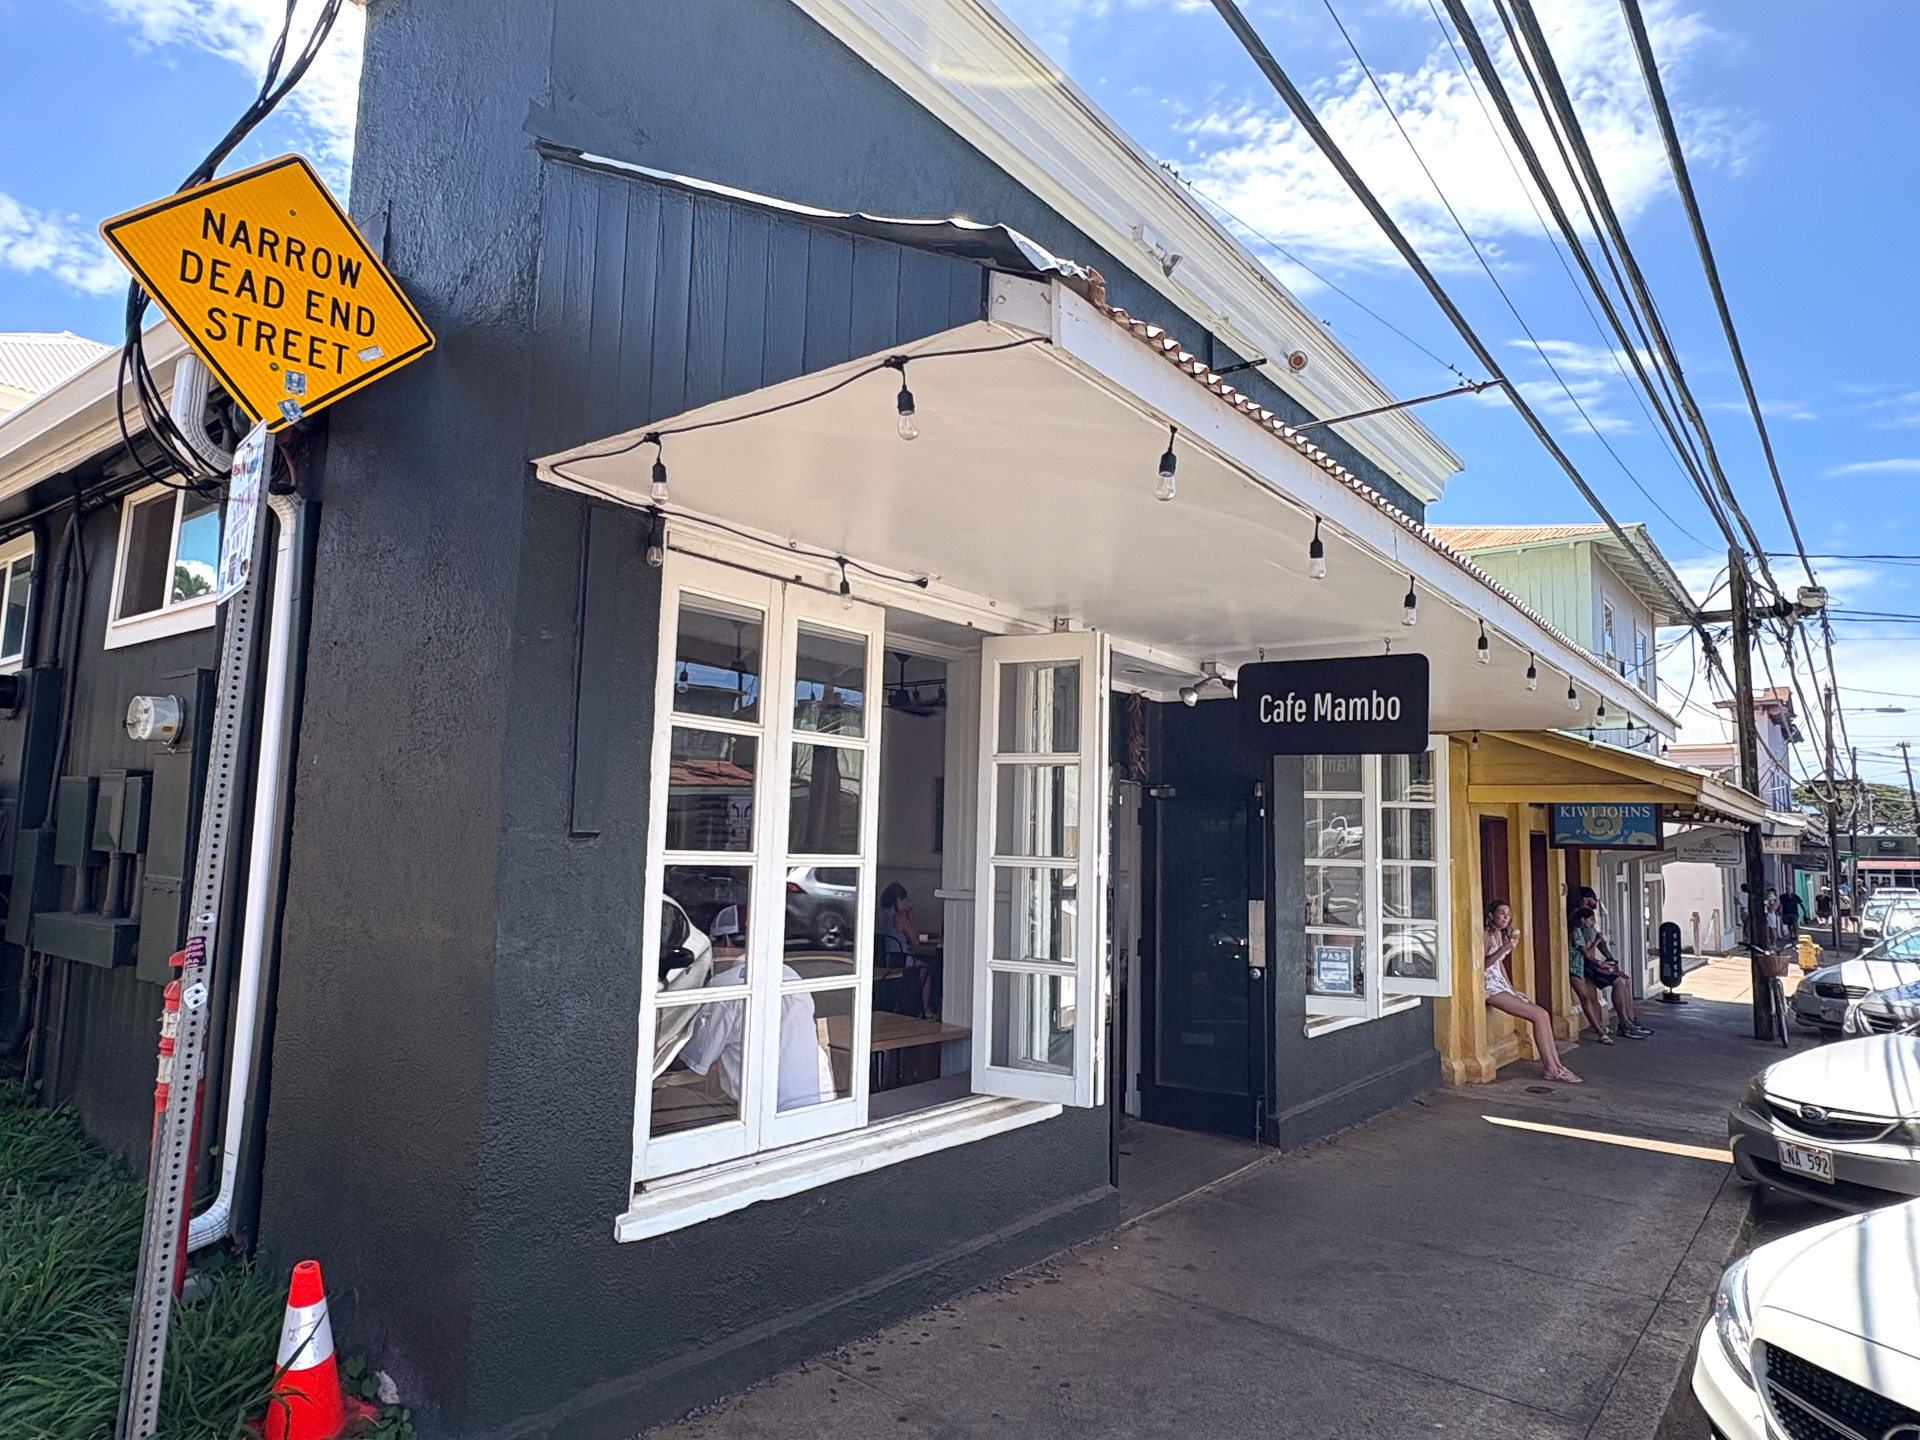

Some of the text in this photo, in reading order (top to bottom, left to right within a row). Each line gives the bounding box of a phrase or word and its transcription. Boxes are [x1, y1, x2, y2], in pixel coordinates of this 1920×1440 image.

[202, 208, 362, 289] NARROW
[180, 249, 376, 338] DEAD END
[204, 307, 349, 375] STREET
[1260, 690, 1401, 723] Cafe Mambo
[1561, 806, 1651, 818] KIWI JOHNS
[1321, 952, 1347, 961] PASS
[1781, 1149, 1802, 1167] LNA
[1807, 1154, 1829, 1174] 592
